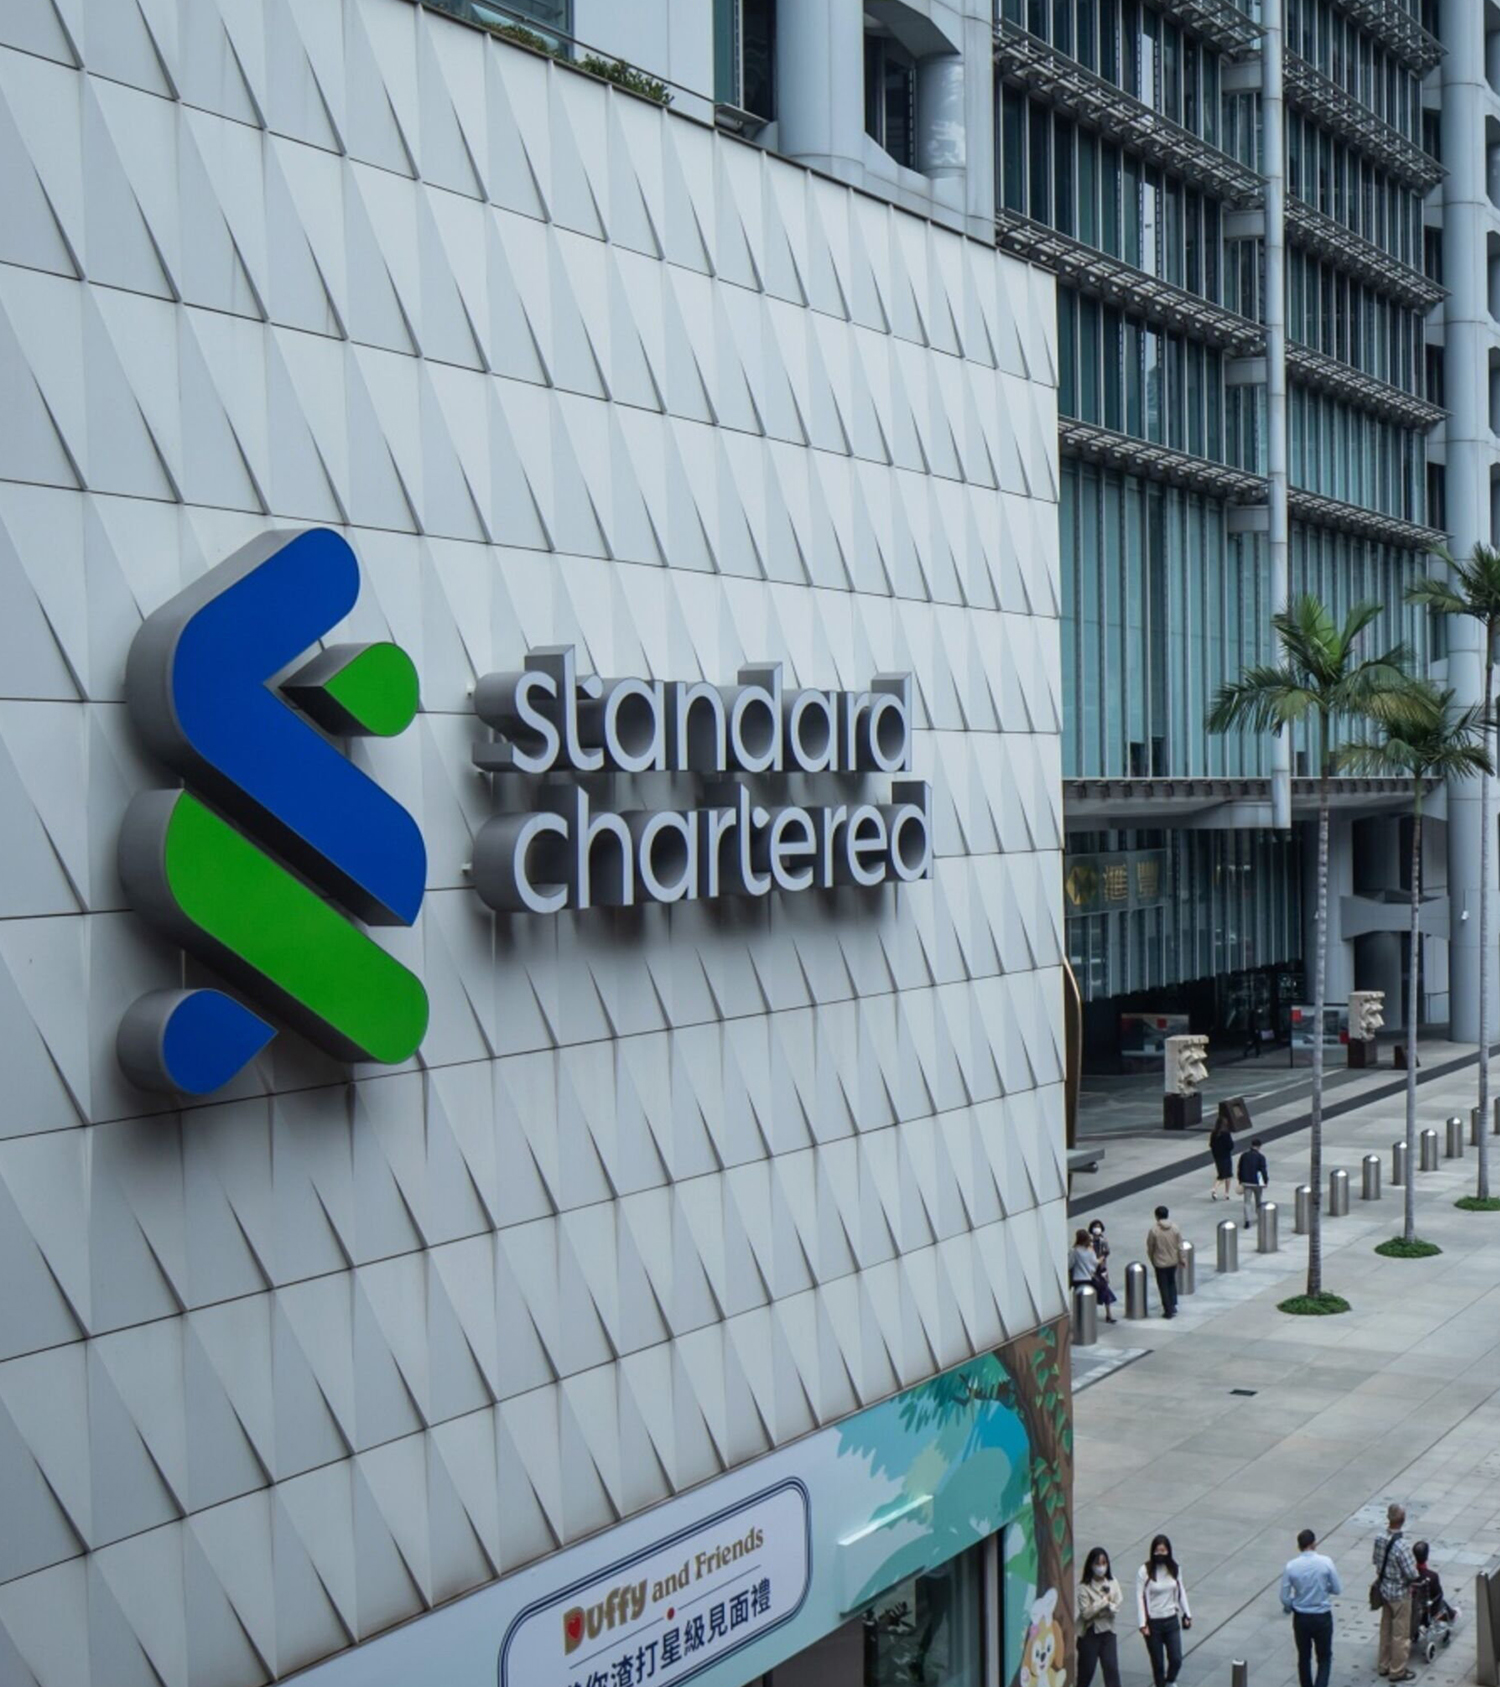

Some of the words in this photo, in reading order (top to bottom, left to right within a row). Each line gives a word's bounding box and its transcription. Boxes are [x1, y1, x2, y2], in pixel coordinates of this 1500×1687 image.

[512, 644, 912, 774] standard
[513, 780, 934, 914] chartered
[563, 1578, 648, 1656] Duffy
[652, 1559, 690, 1603] and
[695, 1526, 765, 1581] Friends
